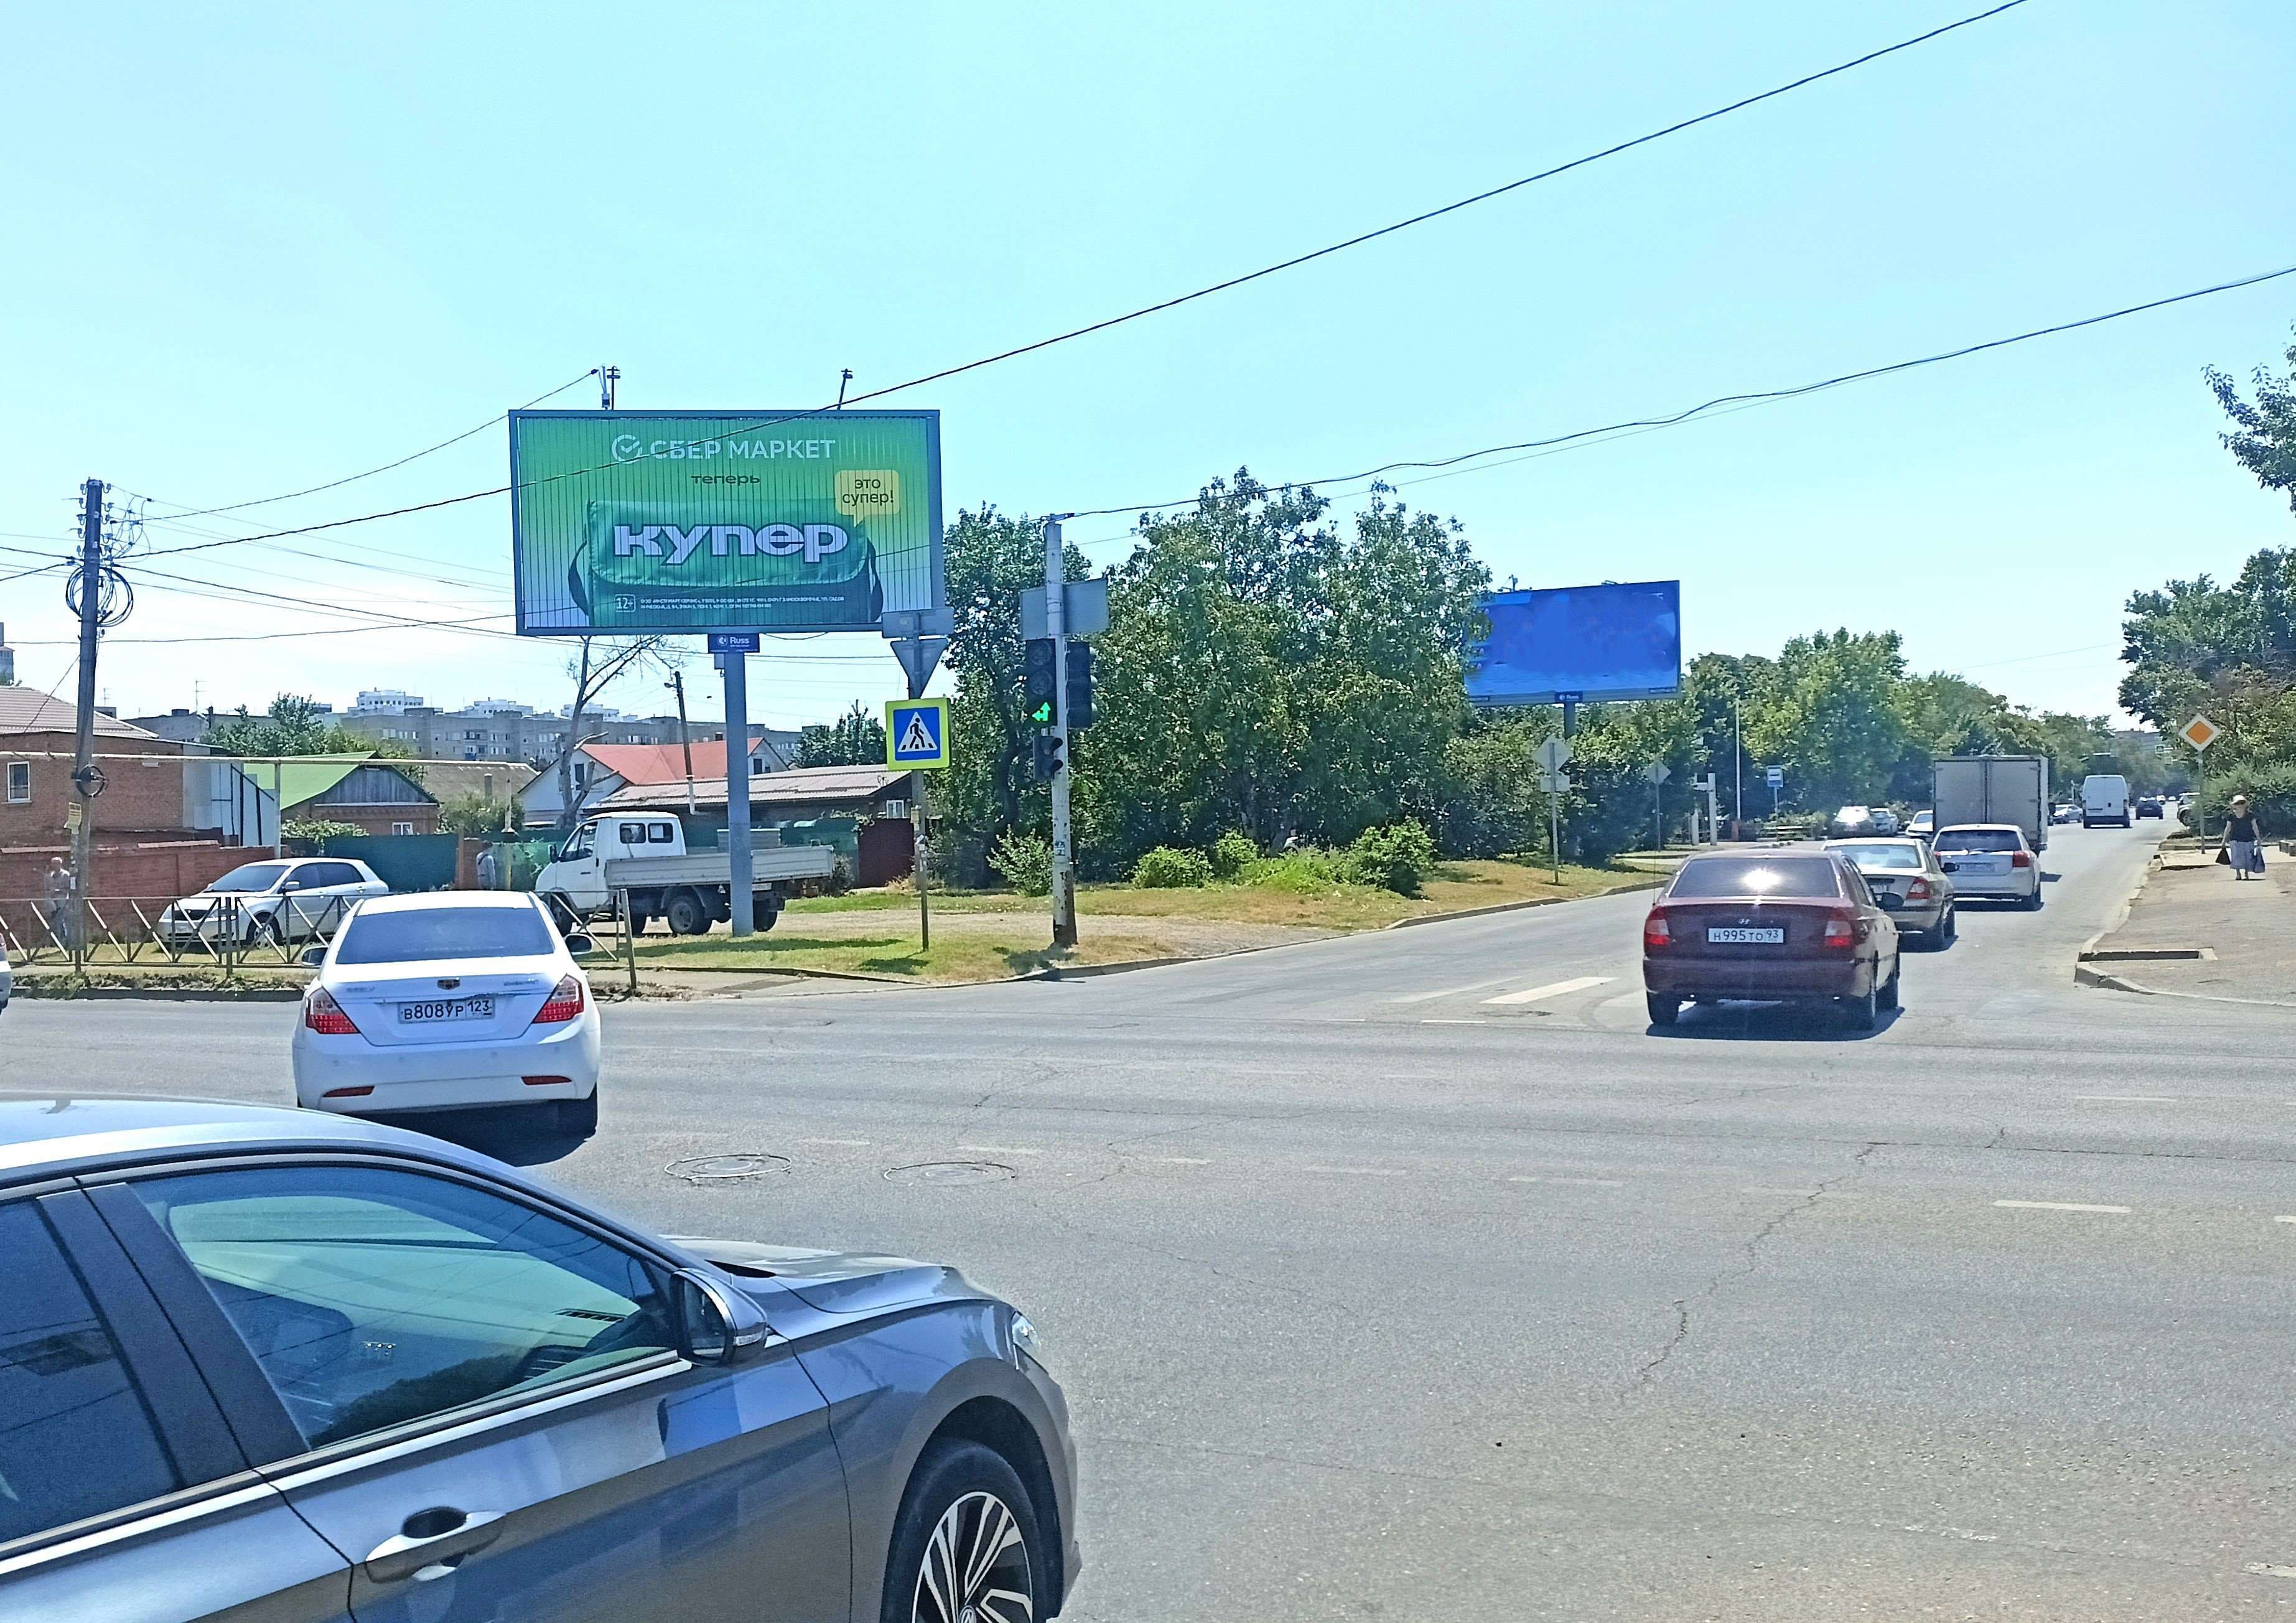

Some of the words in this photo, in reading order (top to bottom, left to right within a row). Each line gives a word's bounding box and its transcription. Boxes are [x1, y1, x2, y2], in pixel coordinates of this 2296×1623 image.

[651, 439, 721, 459] СБЕР
[729, 439, 835, 459] МАРКЕТ
[691, 474, 760, 486] теперь
[855, 479, 881, 489] это
[842, 490, 894, 506] супер!
[614, 523, 848, 564] купер
[615, 597, 633, 609] 12+
[1714, 930, 1763, 941] Н995ТО
[404, 1003, 464, 1019] В808УР
[467, 1000, 489, 1012] 123
